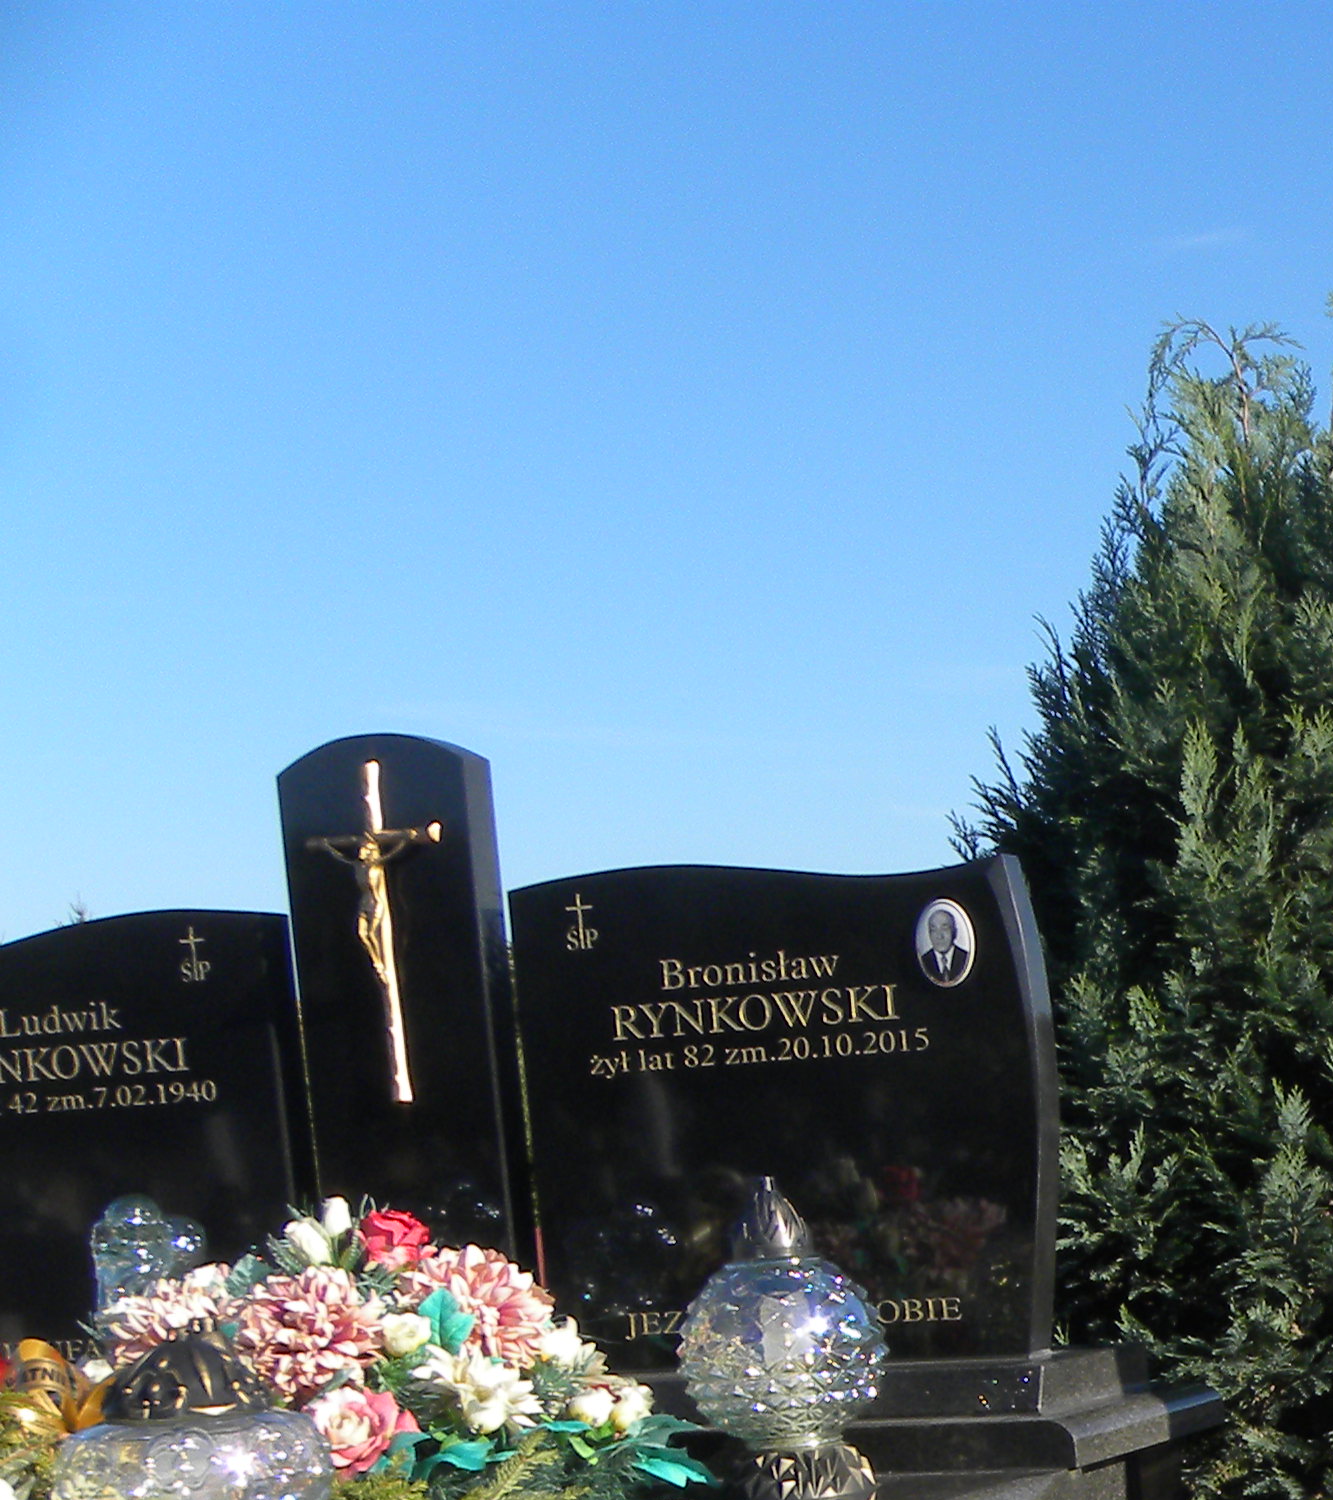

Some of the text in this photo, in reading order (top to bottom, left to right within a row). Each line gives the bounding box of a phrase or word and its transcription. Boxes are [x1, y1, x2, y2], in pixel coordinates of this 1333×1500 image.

[659, 950, 840, 991] Bronisław
[0, 1001, 123, 1038] Ludwik
[610, 984, 901, 1041] RYNKOWSKI
[589, 1050, 630, 1080] żył
[638, 1049, 674, 1073] lat
[683, 1044, 716, 1068] 82
[8, 1091, 39, 1115] 42
[874, 1296, 964, 1326] OBIE
